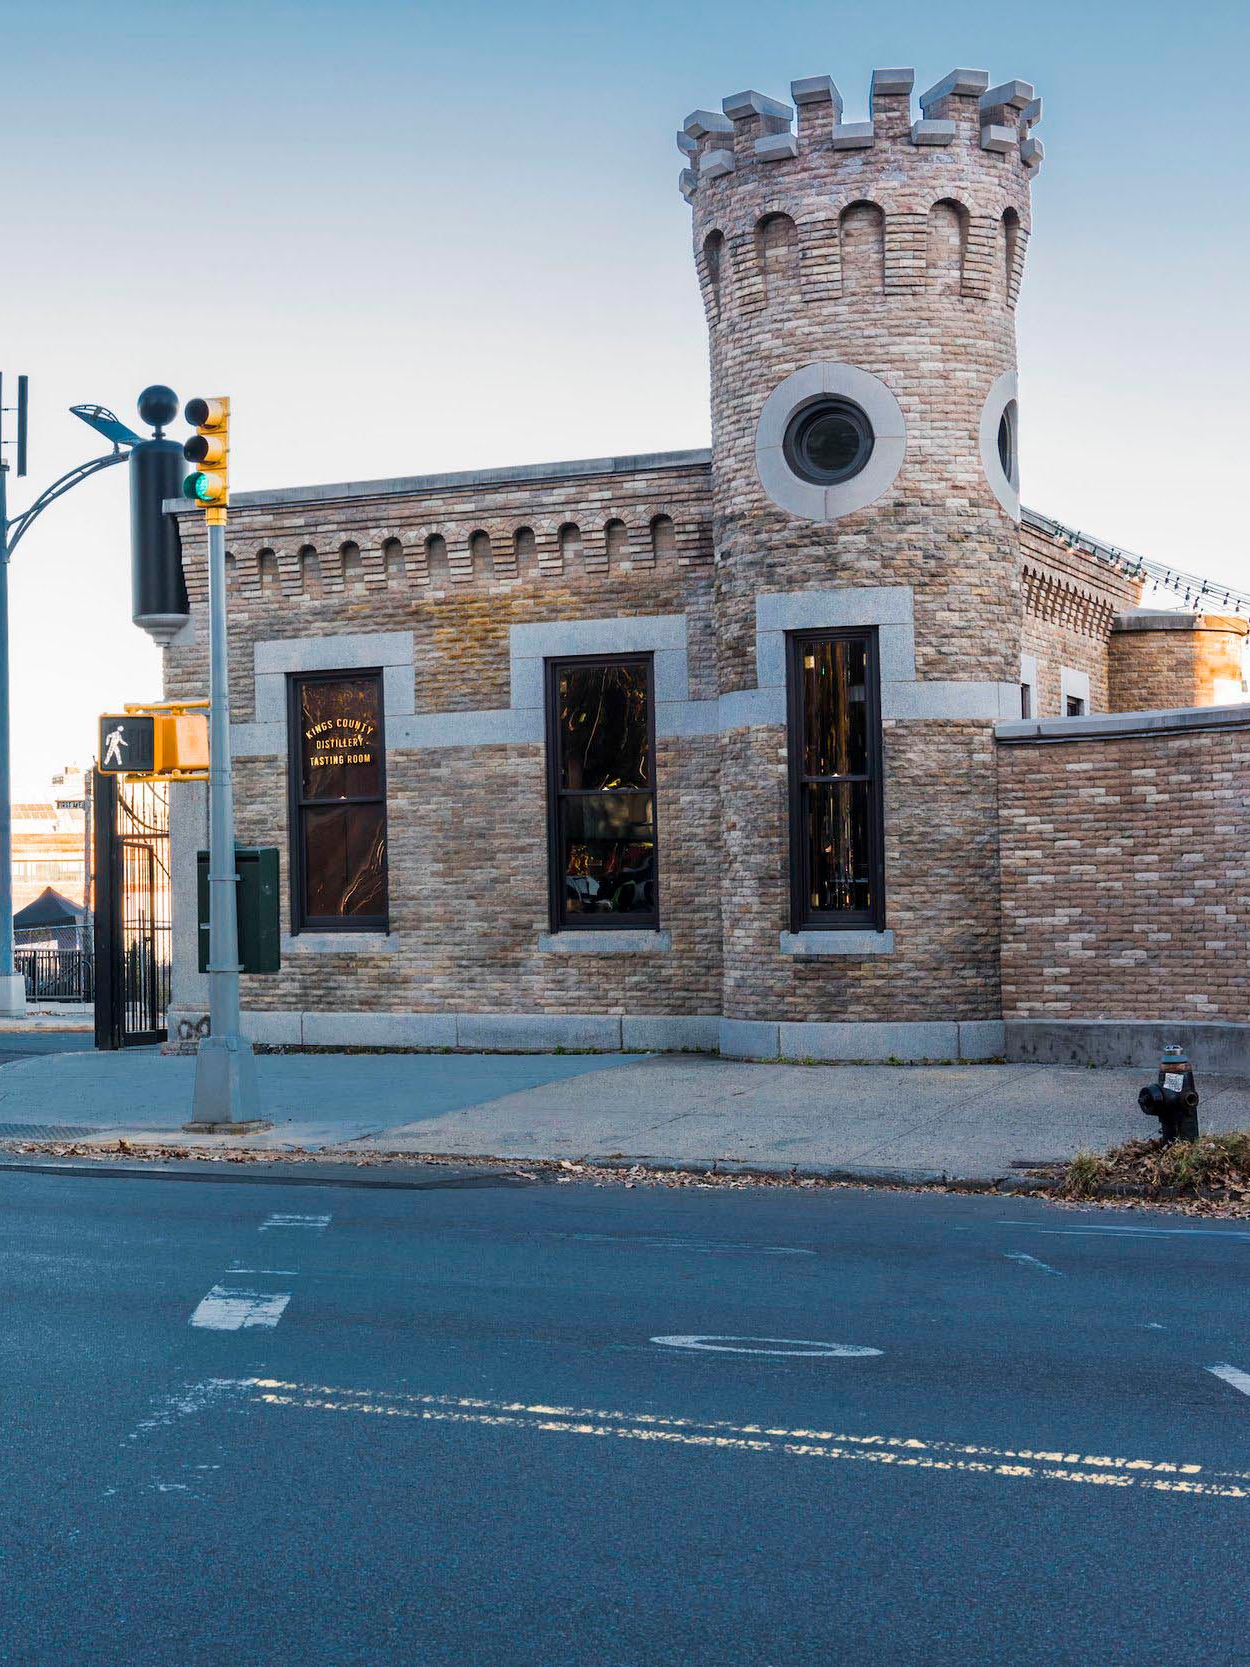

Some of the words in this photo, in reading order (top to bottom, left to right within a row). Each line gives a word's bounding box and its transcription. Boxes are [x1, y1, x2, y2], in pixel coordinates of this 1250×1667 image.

[305, 720, 333, 739] KINGS
[336, 718, 373, 734] COUNTY
[316, 737, 363, 749] DISTILLERY
[310, 755, 344, 765] TASTING
[347, 754, 370, 763] ROOM
